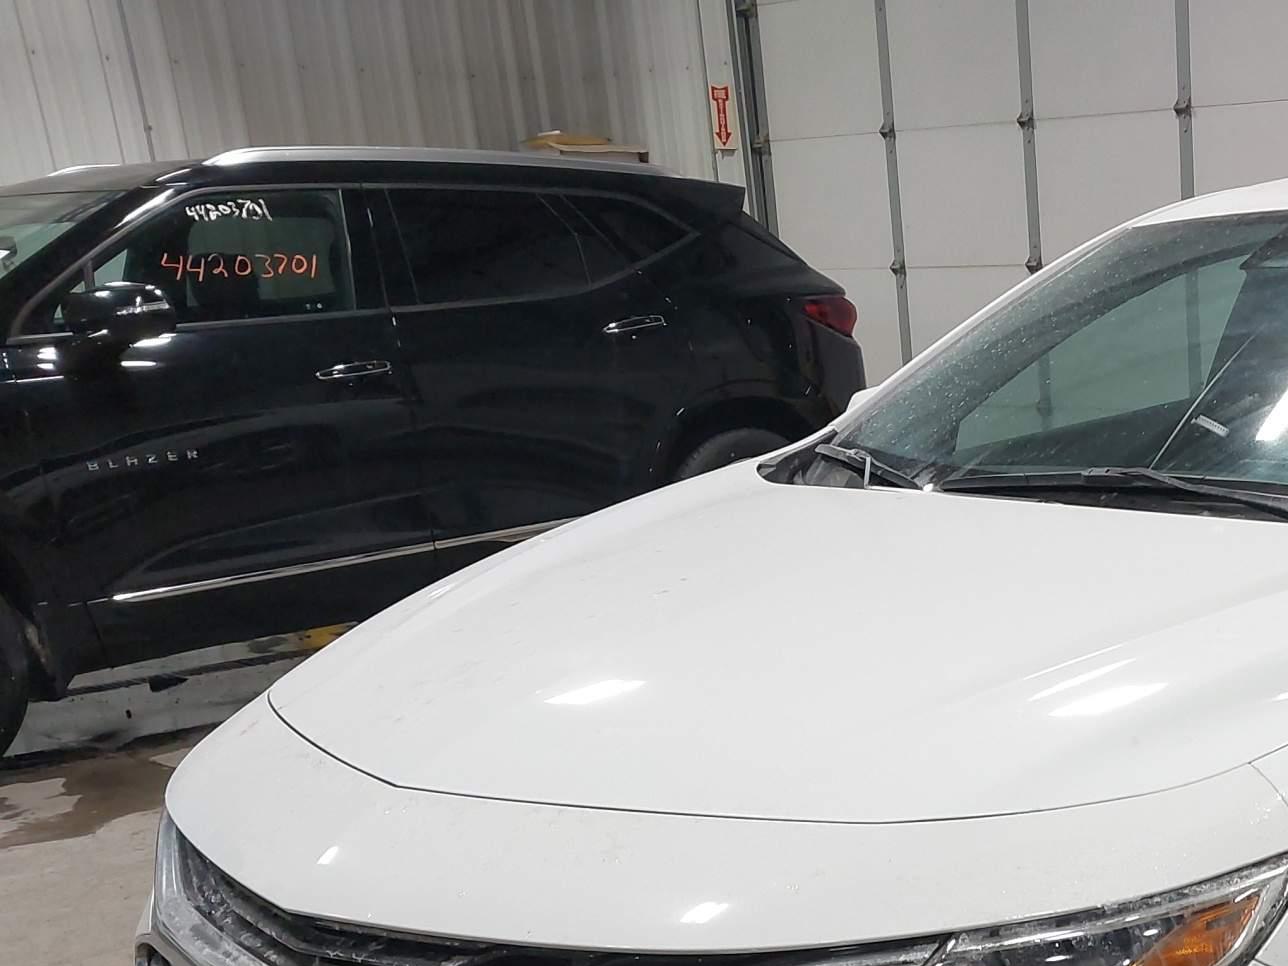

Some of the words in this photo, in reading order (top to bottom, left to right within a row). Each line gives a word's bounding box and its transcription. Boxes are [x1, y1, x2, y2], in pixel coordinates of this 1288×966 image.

[184, 199, 273, 222] 44203701
[161, 253, 317, 282] 44203701
[86, 450, 199, 471] BLAZER
